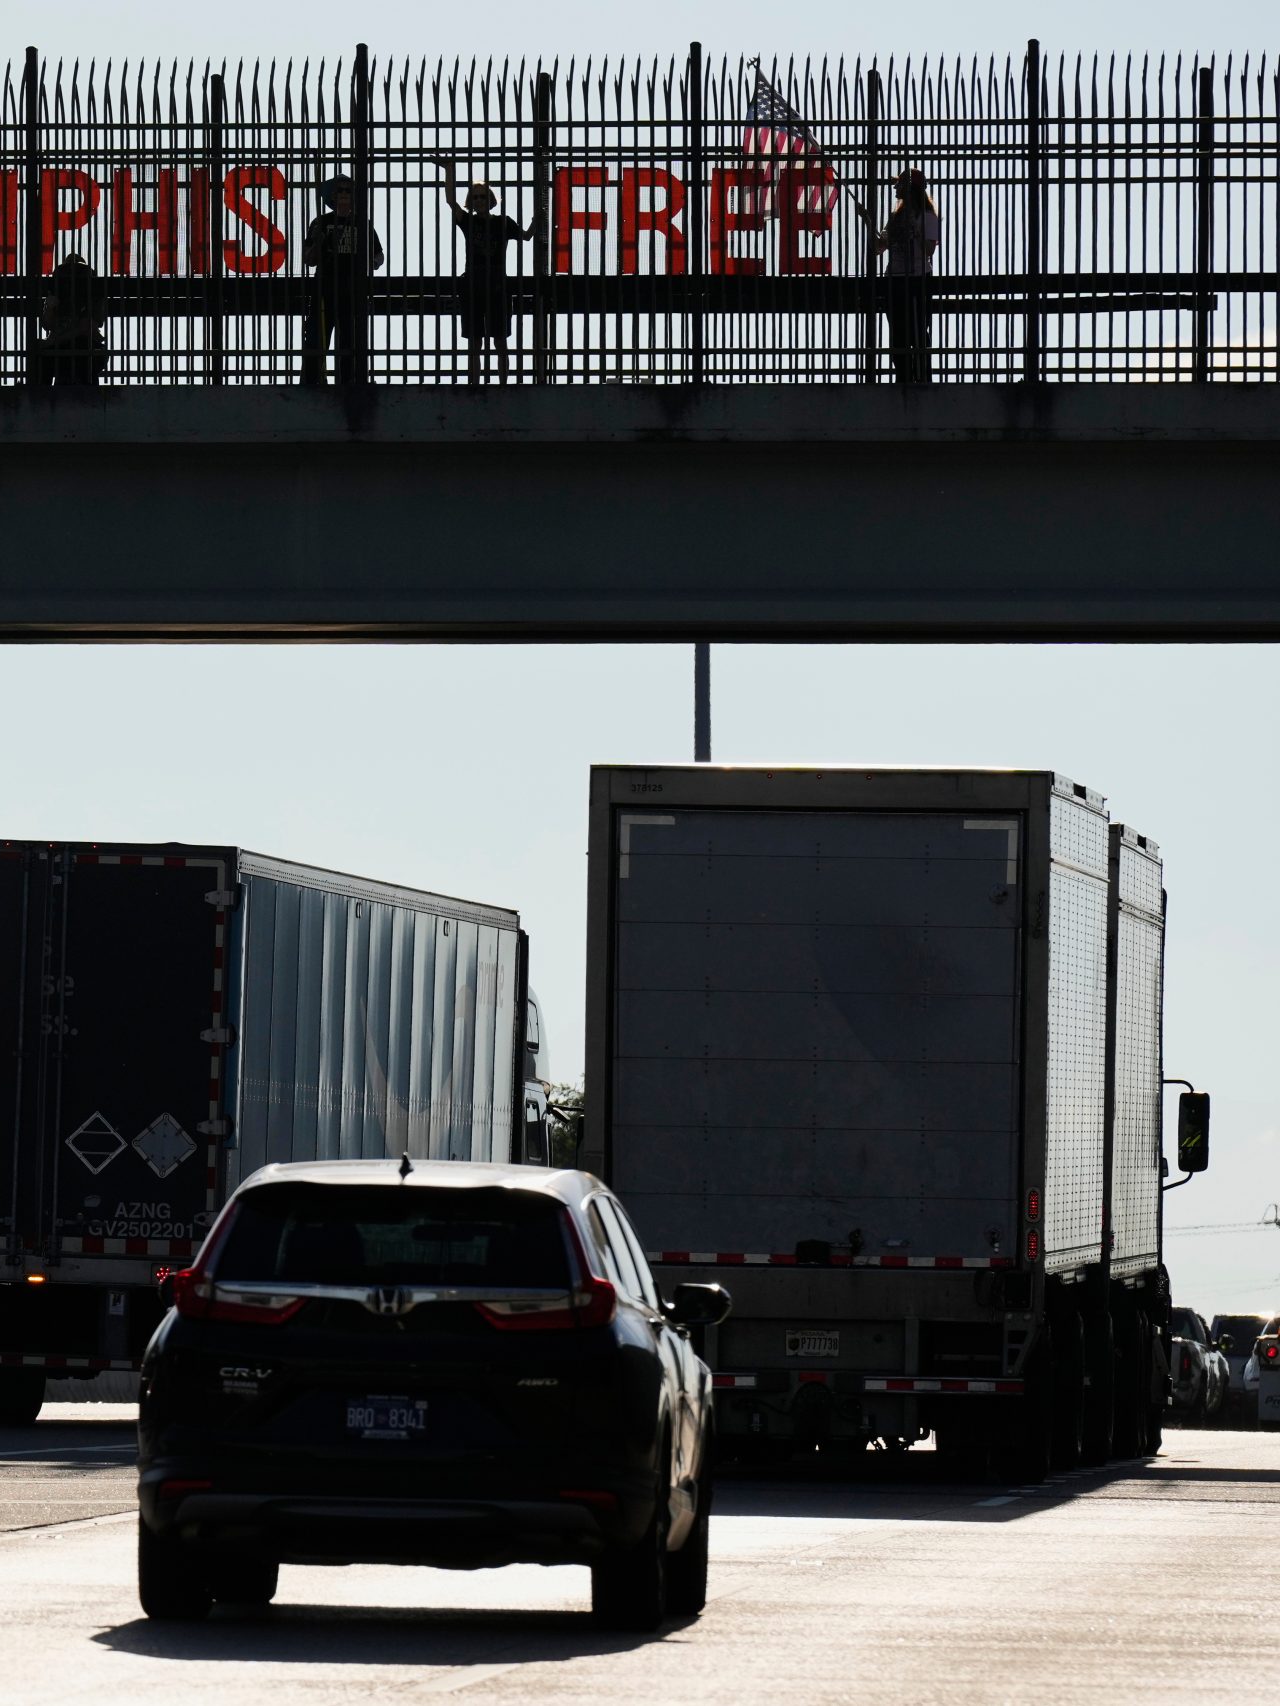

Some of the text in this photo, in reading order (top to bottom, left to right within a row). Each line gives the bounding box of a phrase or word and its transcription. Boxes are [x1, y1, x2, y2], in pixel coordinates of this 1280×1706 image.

[554, 166, 834, 276] FREE
[114, 1201, 171, 1220] AZNG
[88, 1219, 194, 1239] GV2502201
[219, 1367, 273, 1378] CR-V
[388, 1408, 426, 1429] 8341
